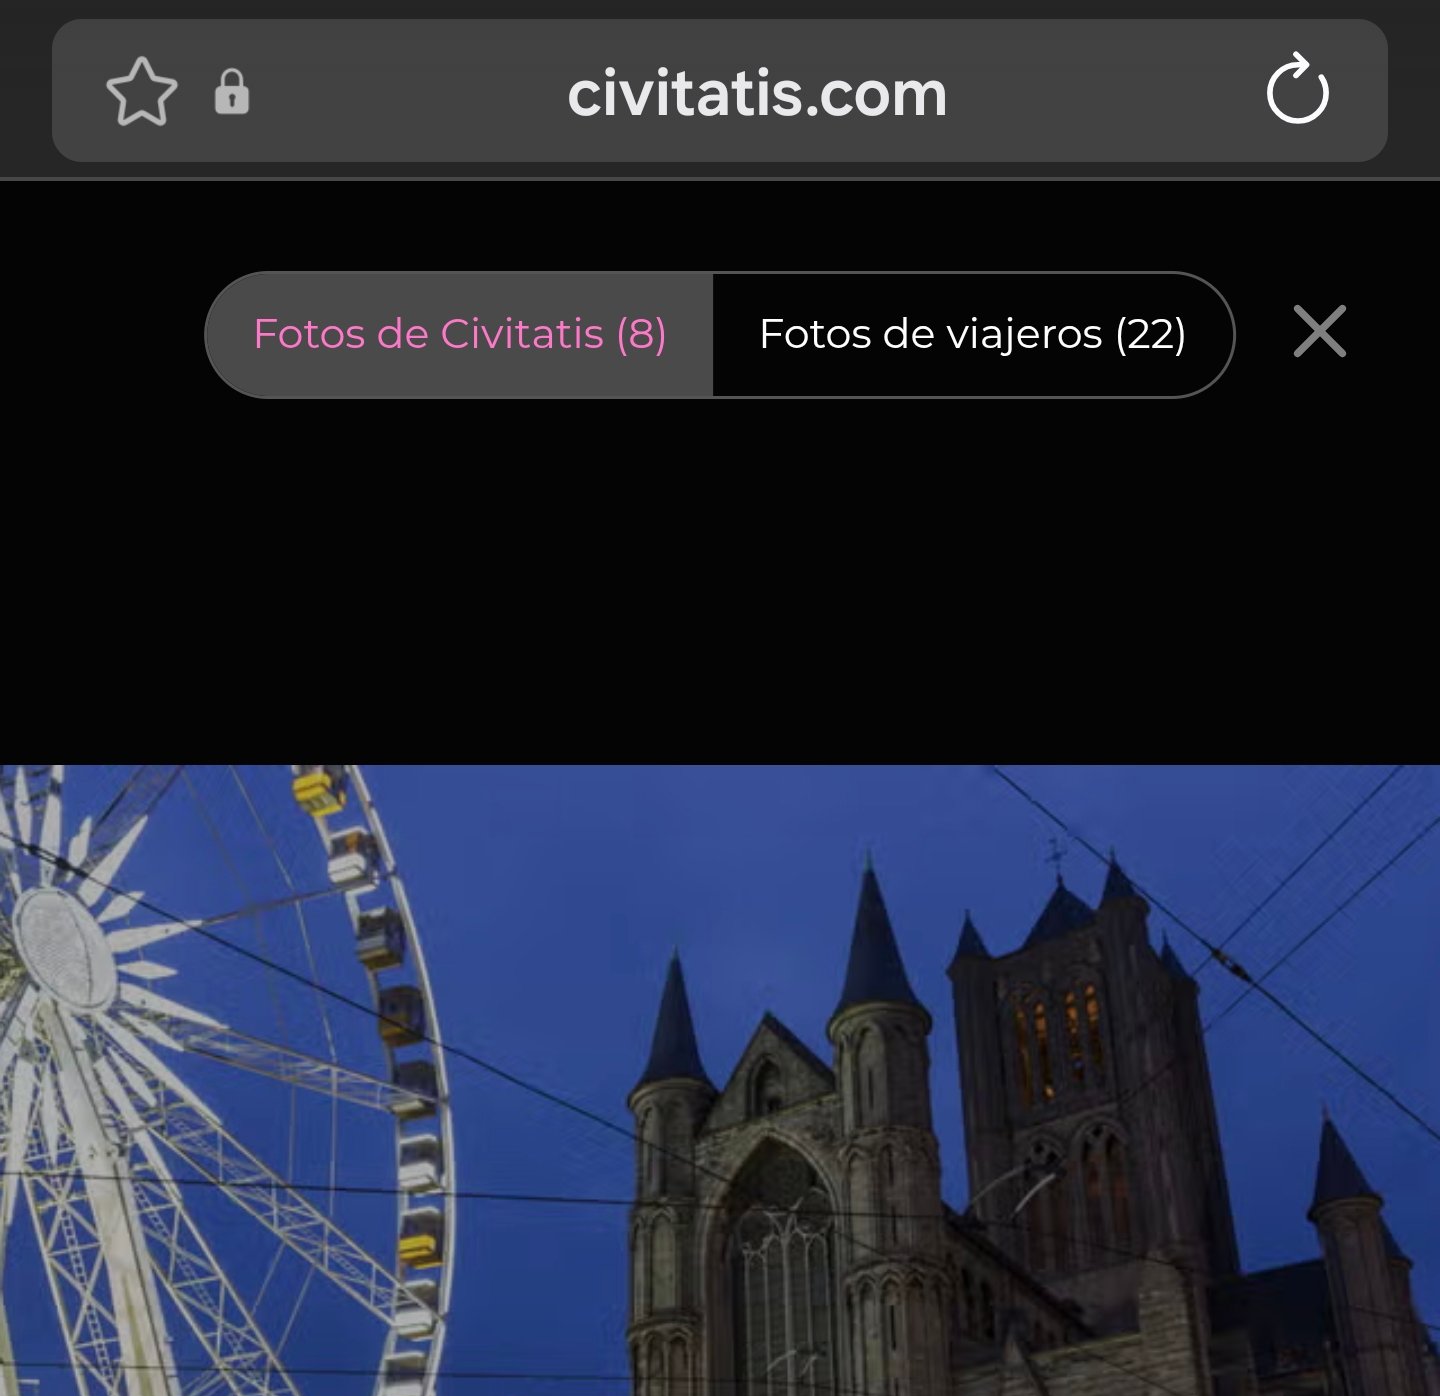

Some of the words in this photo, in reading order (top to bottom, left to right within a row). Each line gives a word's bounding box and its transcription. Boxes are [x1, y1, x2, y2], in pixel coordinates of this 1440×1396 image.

[568, 66, 946, 117] civitatis.com
[256, 318, 365, 349] Fotos
[377, 316, 429, 349] de
[441, 316, 604, 349] Civitatis
[618, 316, 665, 357] (8)
[762, 318, 872, 349] Fotos
[883, 316, 935, 349] de
[946, 316, 1103, 357] viajeros
[1117, 316, 1185, 357] (22)
